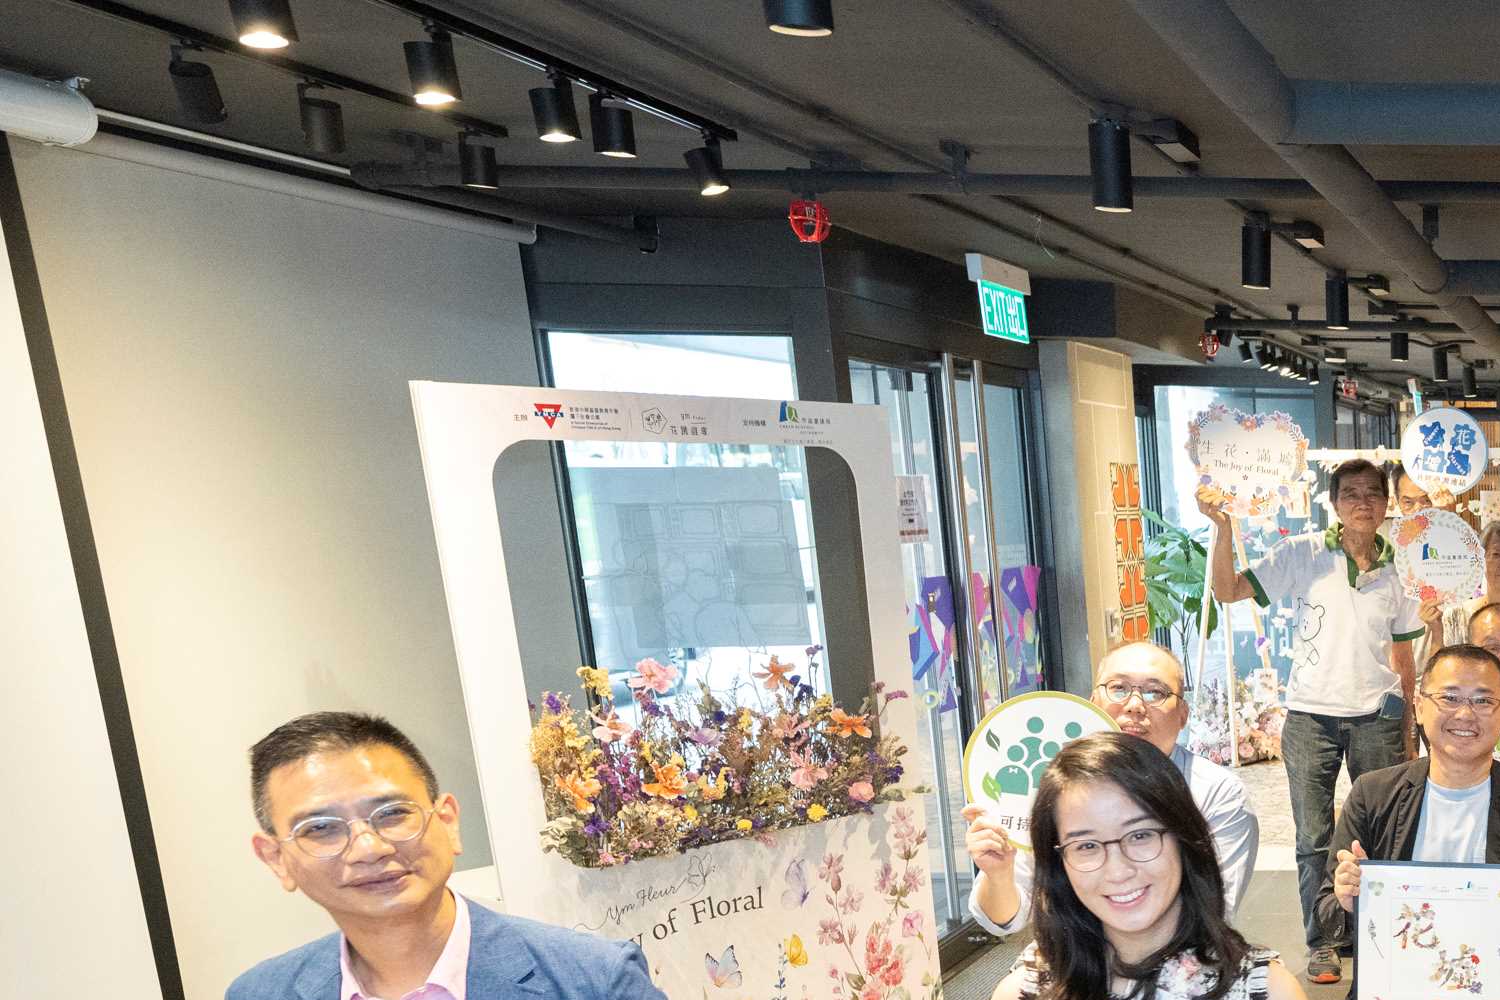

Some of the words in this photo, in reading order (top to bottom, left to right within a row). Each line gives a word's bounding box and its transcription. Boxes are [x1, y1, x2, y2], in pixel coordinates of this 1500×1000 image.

[982, 287, 1009, 335] EXIT
[1006, 294, 1028, 338] 出口
[1455, 428, 1472, 446] 花
[1214, 459, 1229, 468] The
[1244, 464, 1254, 472] of
[1256, 465, 1279, 476] Floral
[652, 908, 679, 940] of
[690, 886, 765, 925] Floral
